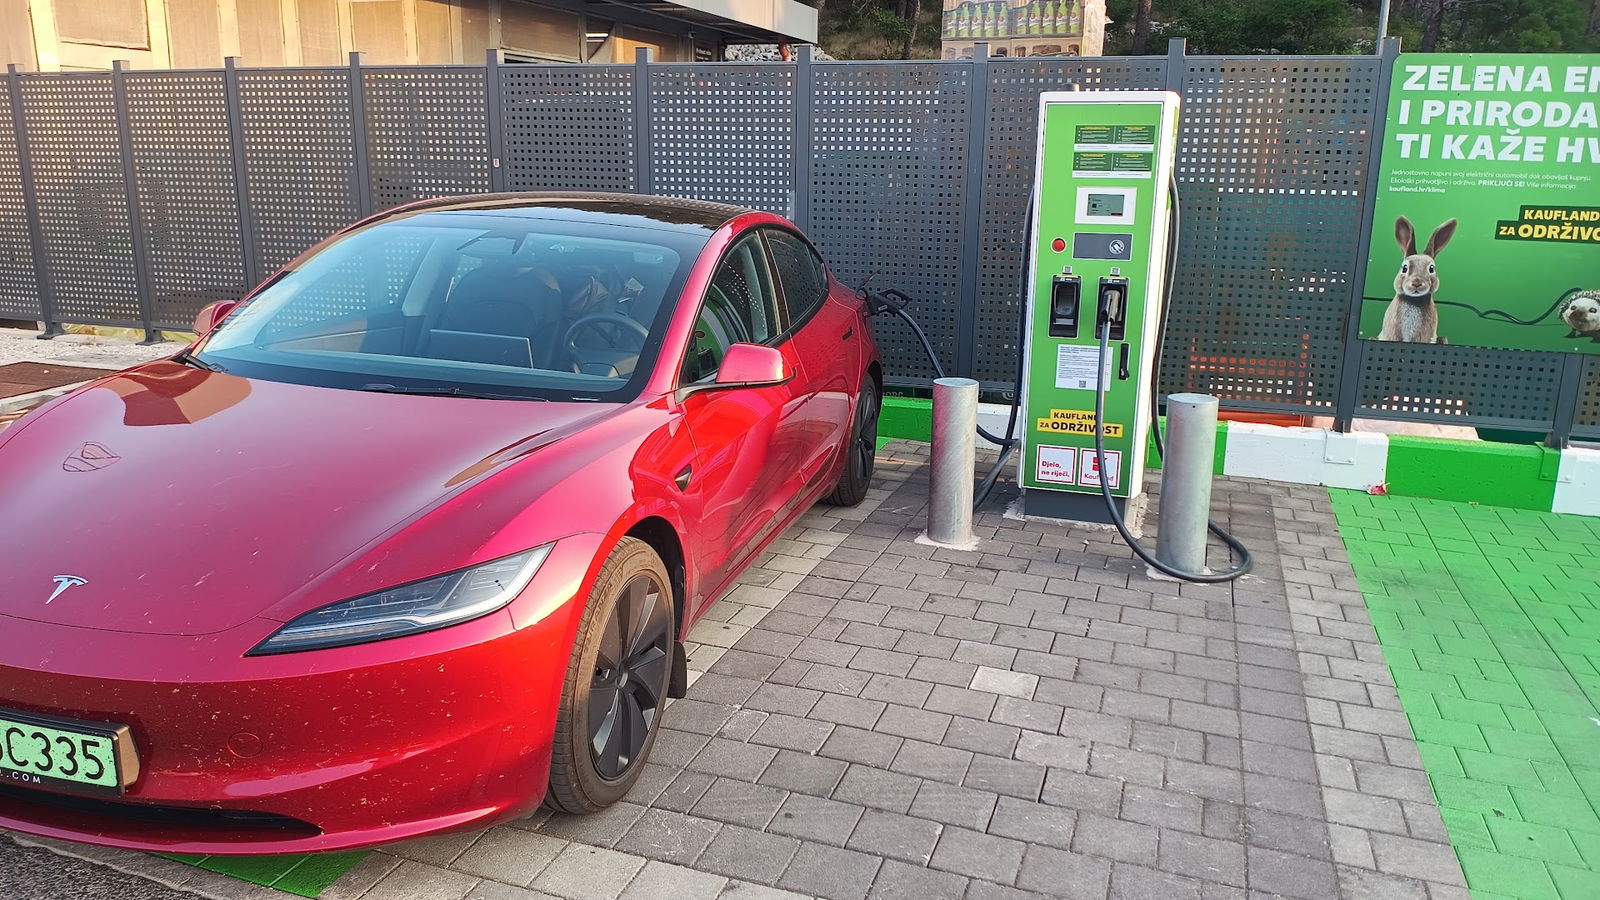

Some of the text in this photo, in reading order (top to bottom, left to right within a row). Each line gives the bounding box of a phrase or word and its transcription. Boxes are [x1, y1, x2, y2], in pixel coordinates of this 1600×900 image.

[1402, 65, 1552, 92] ZELENA
[1398, 99, 1599, 128] I PRIRODA
[1396, 133, 1431, 159] TI
[1441, 128, 1547, 161] KAŽE
[1431, 170, 1451, 178] napuni
[1478, 179, 1513, 187] PRIKLJUČI
[1389, 185, 1446, 193] kaufland.hr/klima
[1523, 209, 1600, 221] KAUFLAND
[1500, 226, 1515, 235] ZA
[1053, 412, 1096, 420] KAUFLAN
[1051, 420, 1120, 434] ODRŽIVST
[1041, 460, 1061, 469] Djela,
[0, 727, 105, 780] C335
